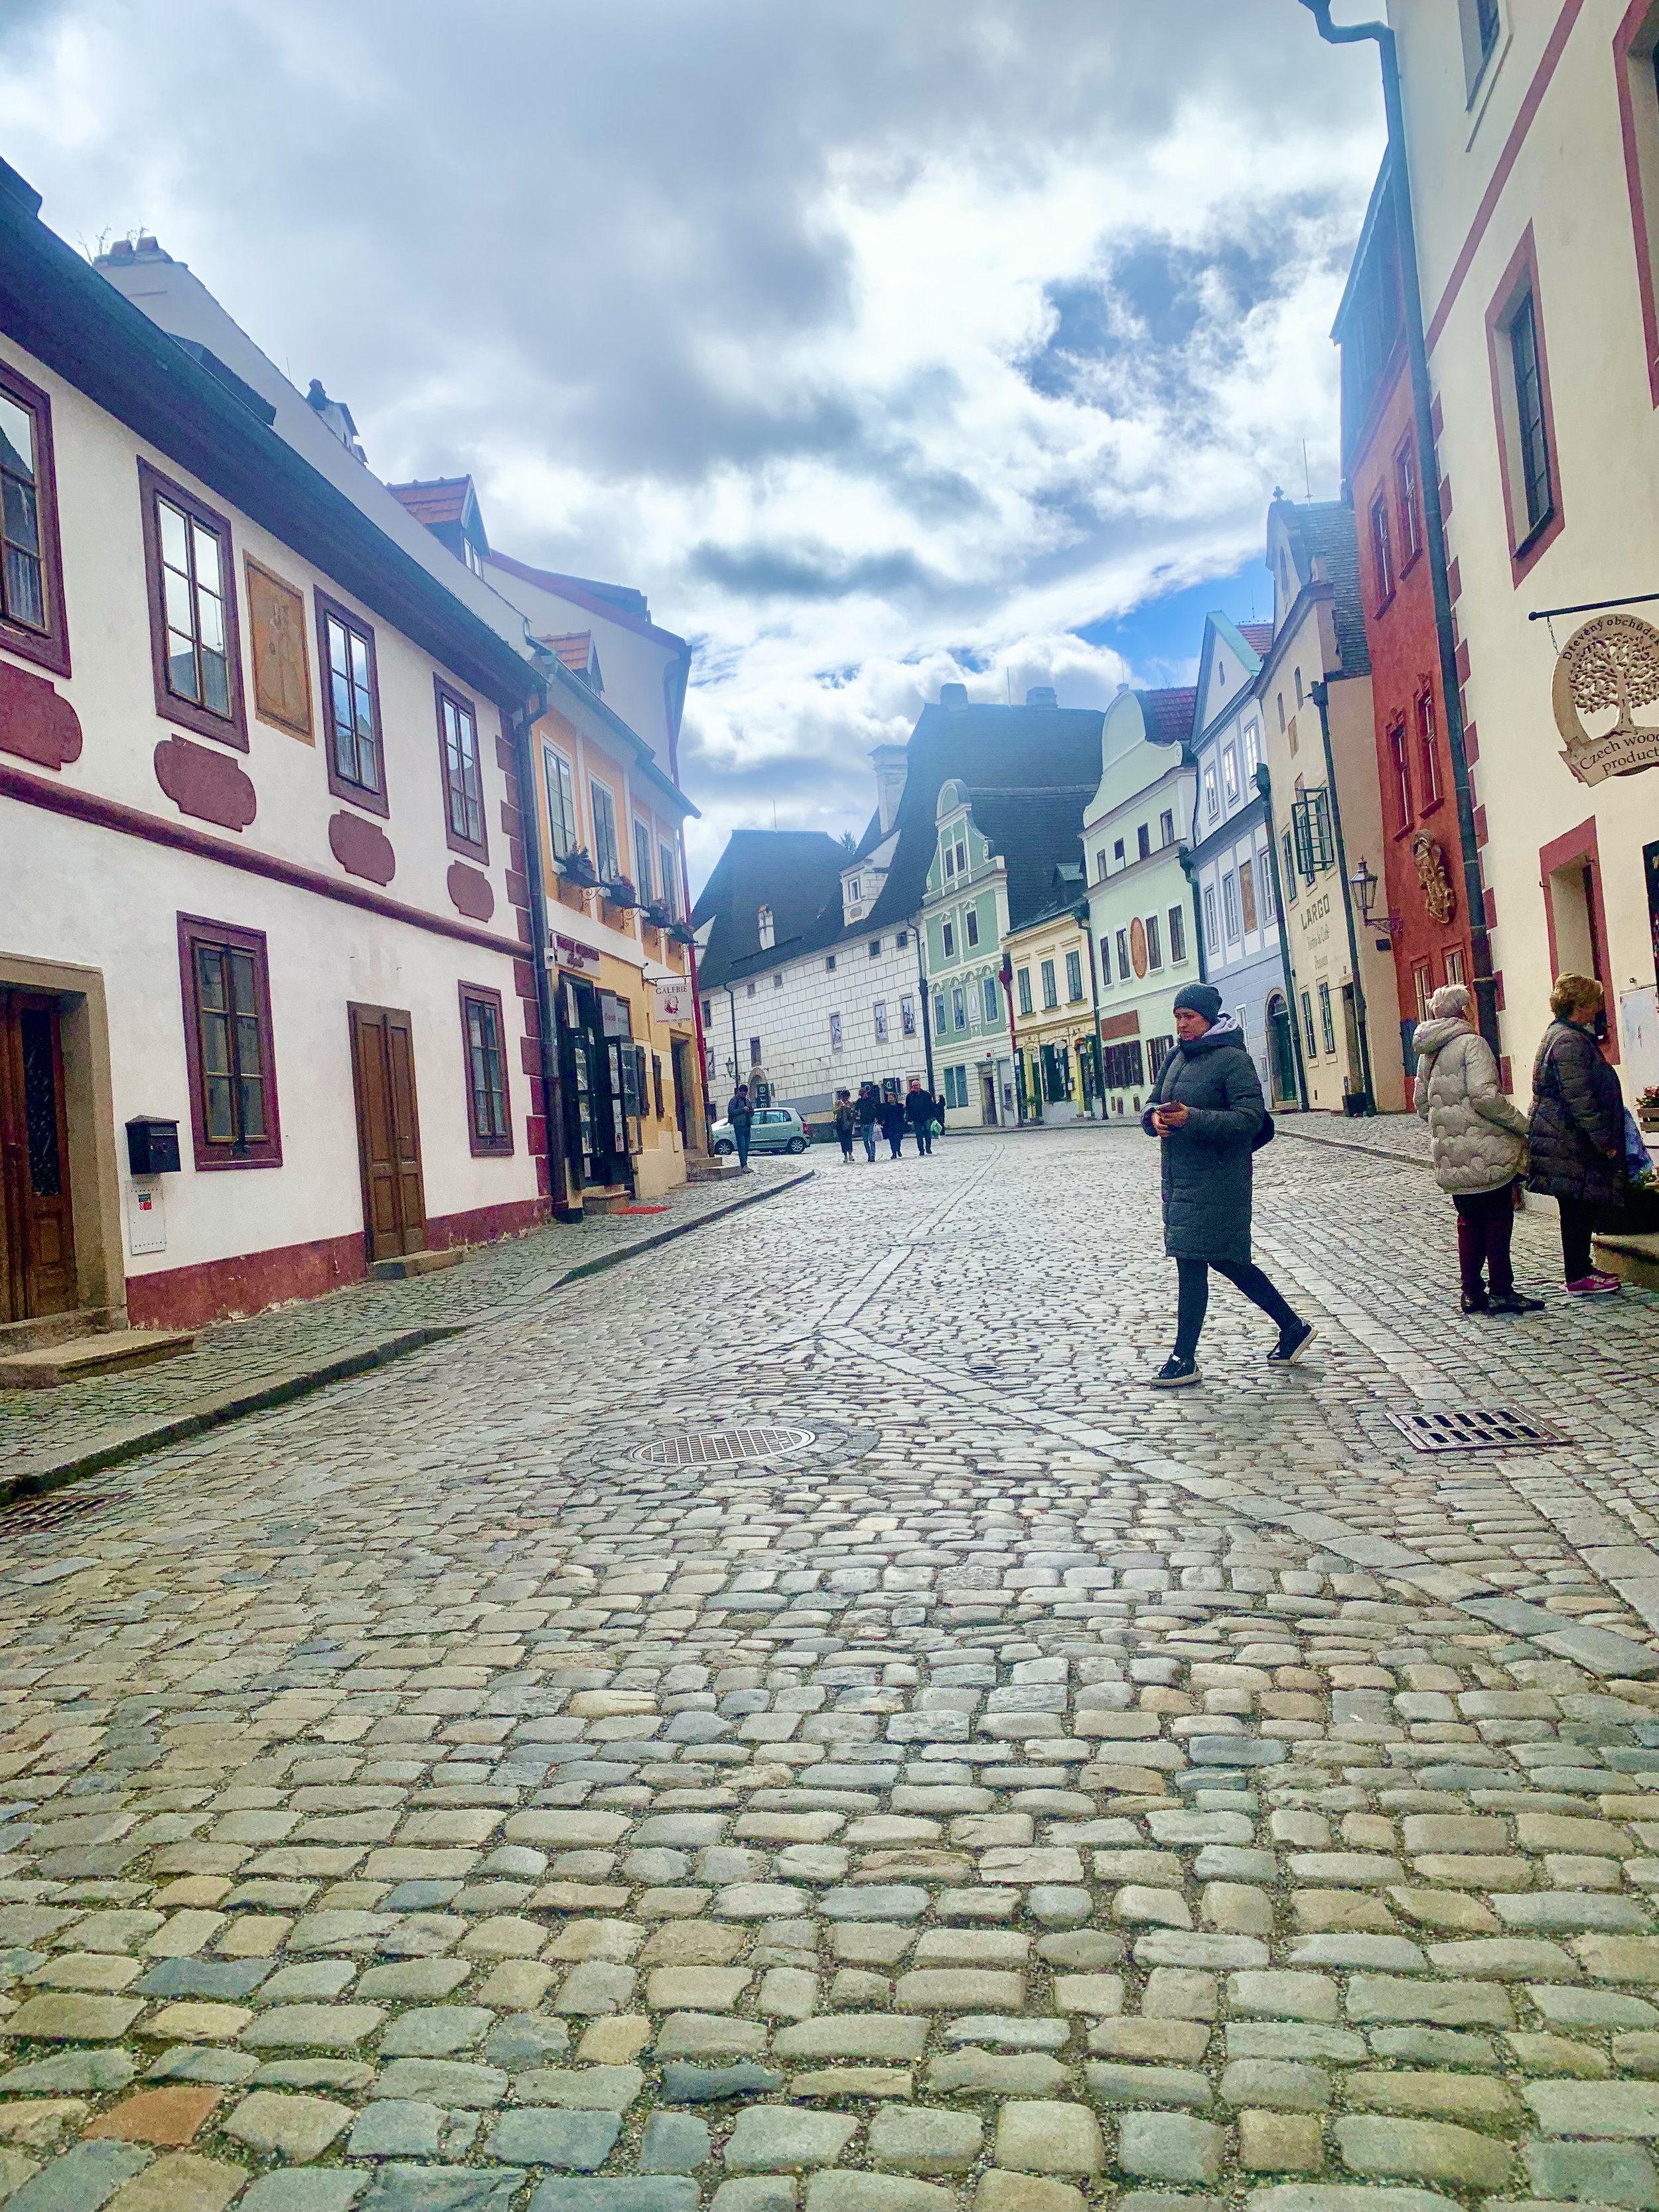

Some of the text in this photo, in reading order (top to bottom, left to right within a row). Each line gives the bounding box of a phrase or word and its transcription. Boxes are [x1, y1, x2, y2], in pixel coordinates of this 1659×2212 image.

[1562, 619, 1603, 661] Dřevěný
[1580, 741, 1621, 770] Czech
[1301, 893, 1330, 930] LARGO
[656, 986, 687, 995] GALERIE
